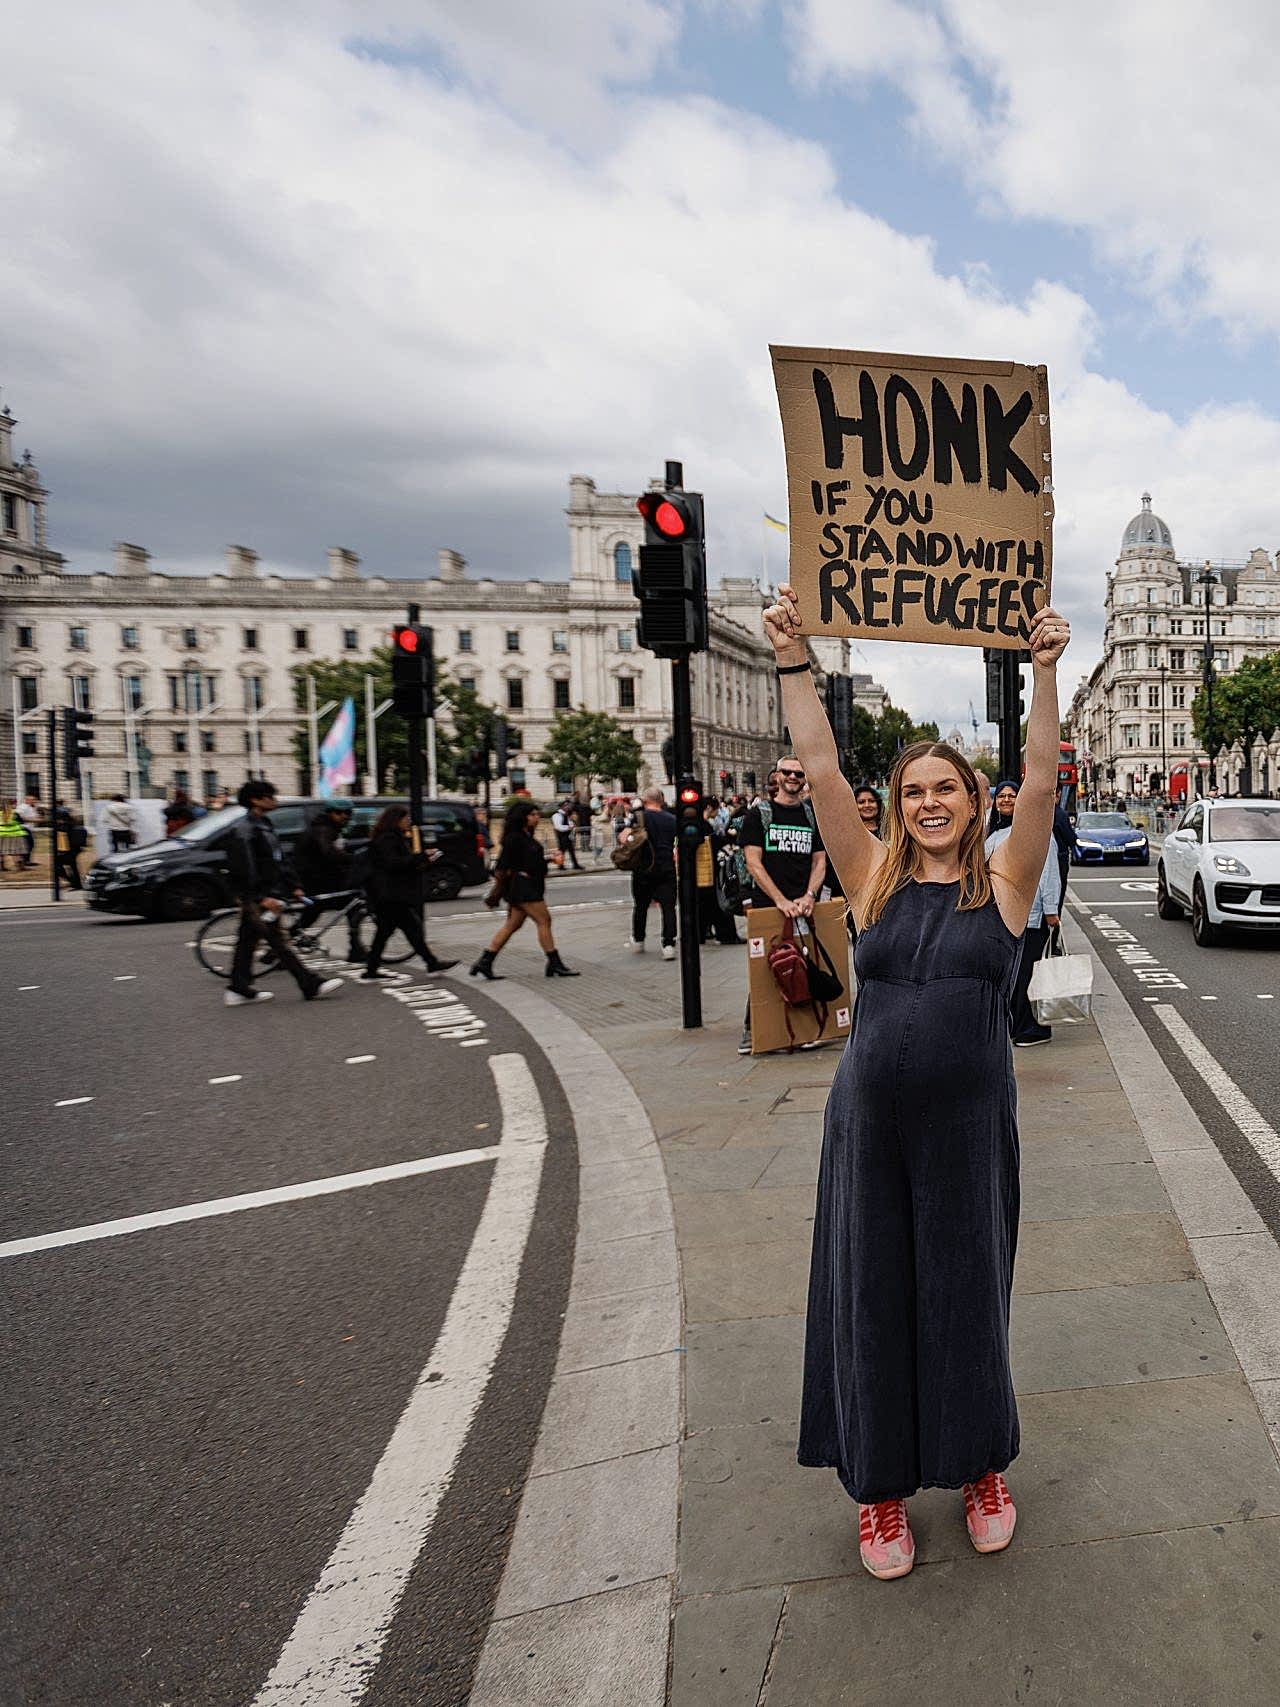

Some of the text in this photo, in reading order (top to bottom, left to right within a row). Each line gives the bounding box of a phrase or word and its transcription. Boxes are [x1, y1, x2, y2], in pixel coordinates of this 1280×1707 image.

[812, 367, 1040, 497] HONK
[811, 480, 933, 525] IF YOU
[819, 522, 1044, 579] STAND WITH
[819, 559, 1045, 643] REFUGEES
[769, 828, 812, 842] REFUGEE
[778, 839, 812, 854] ACTION
[1132, 968, 1189, 990] LEFT
